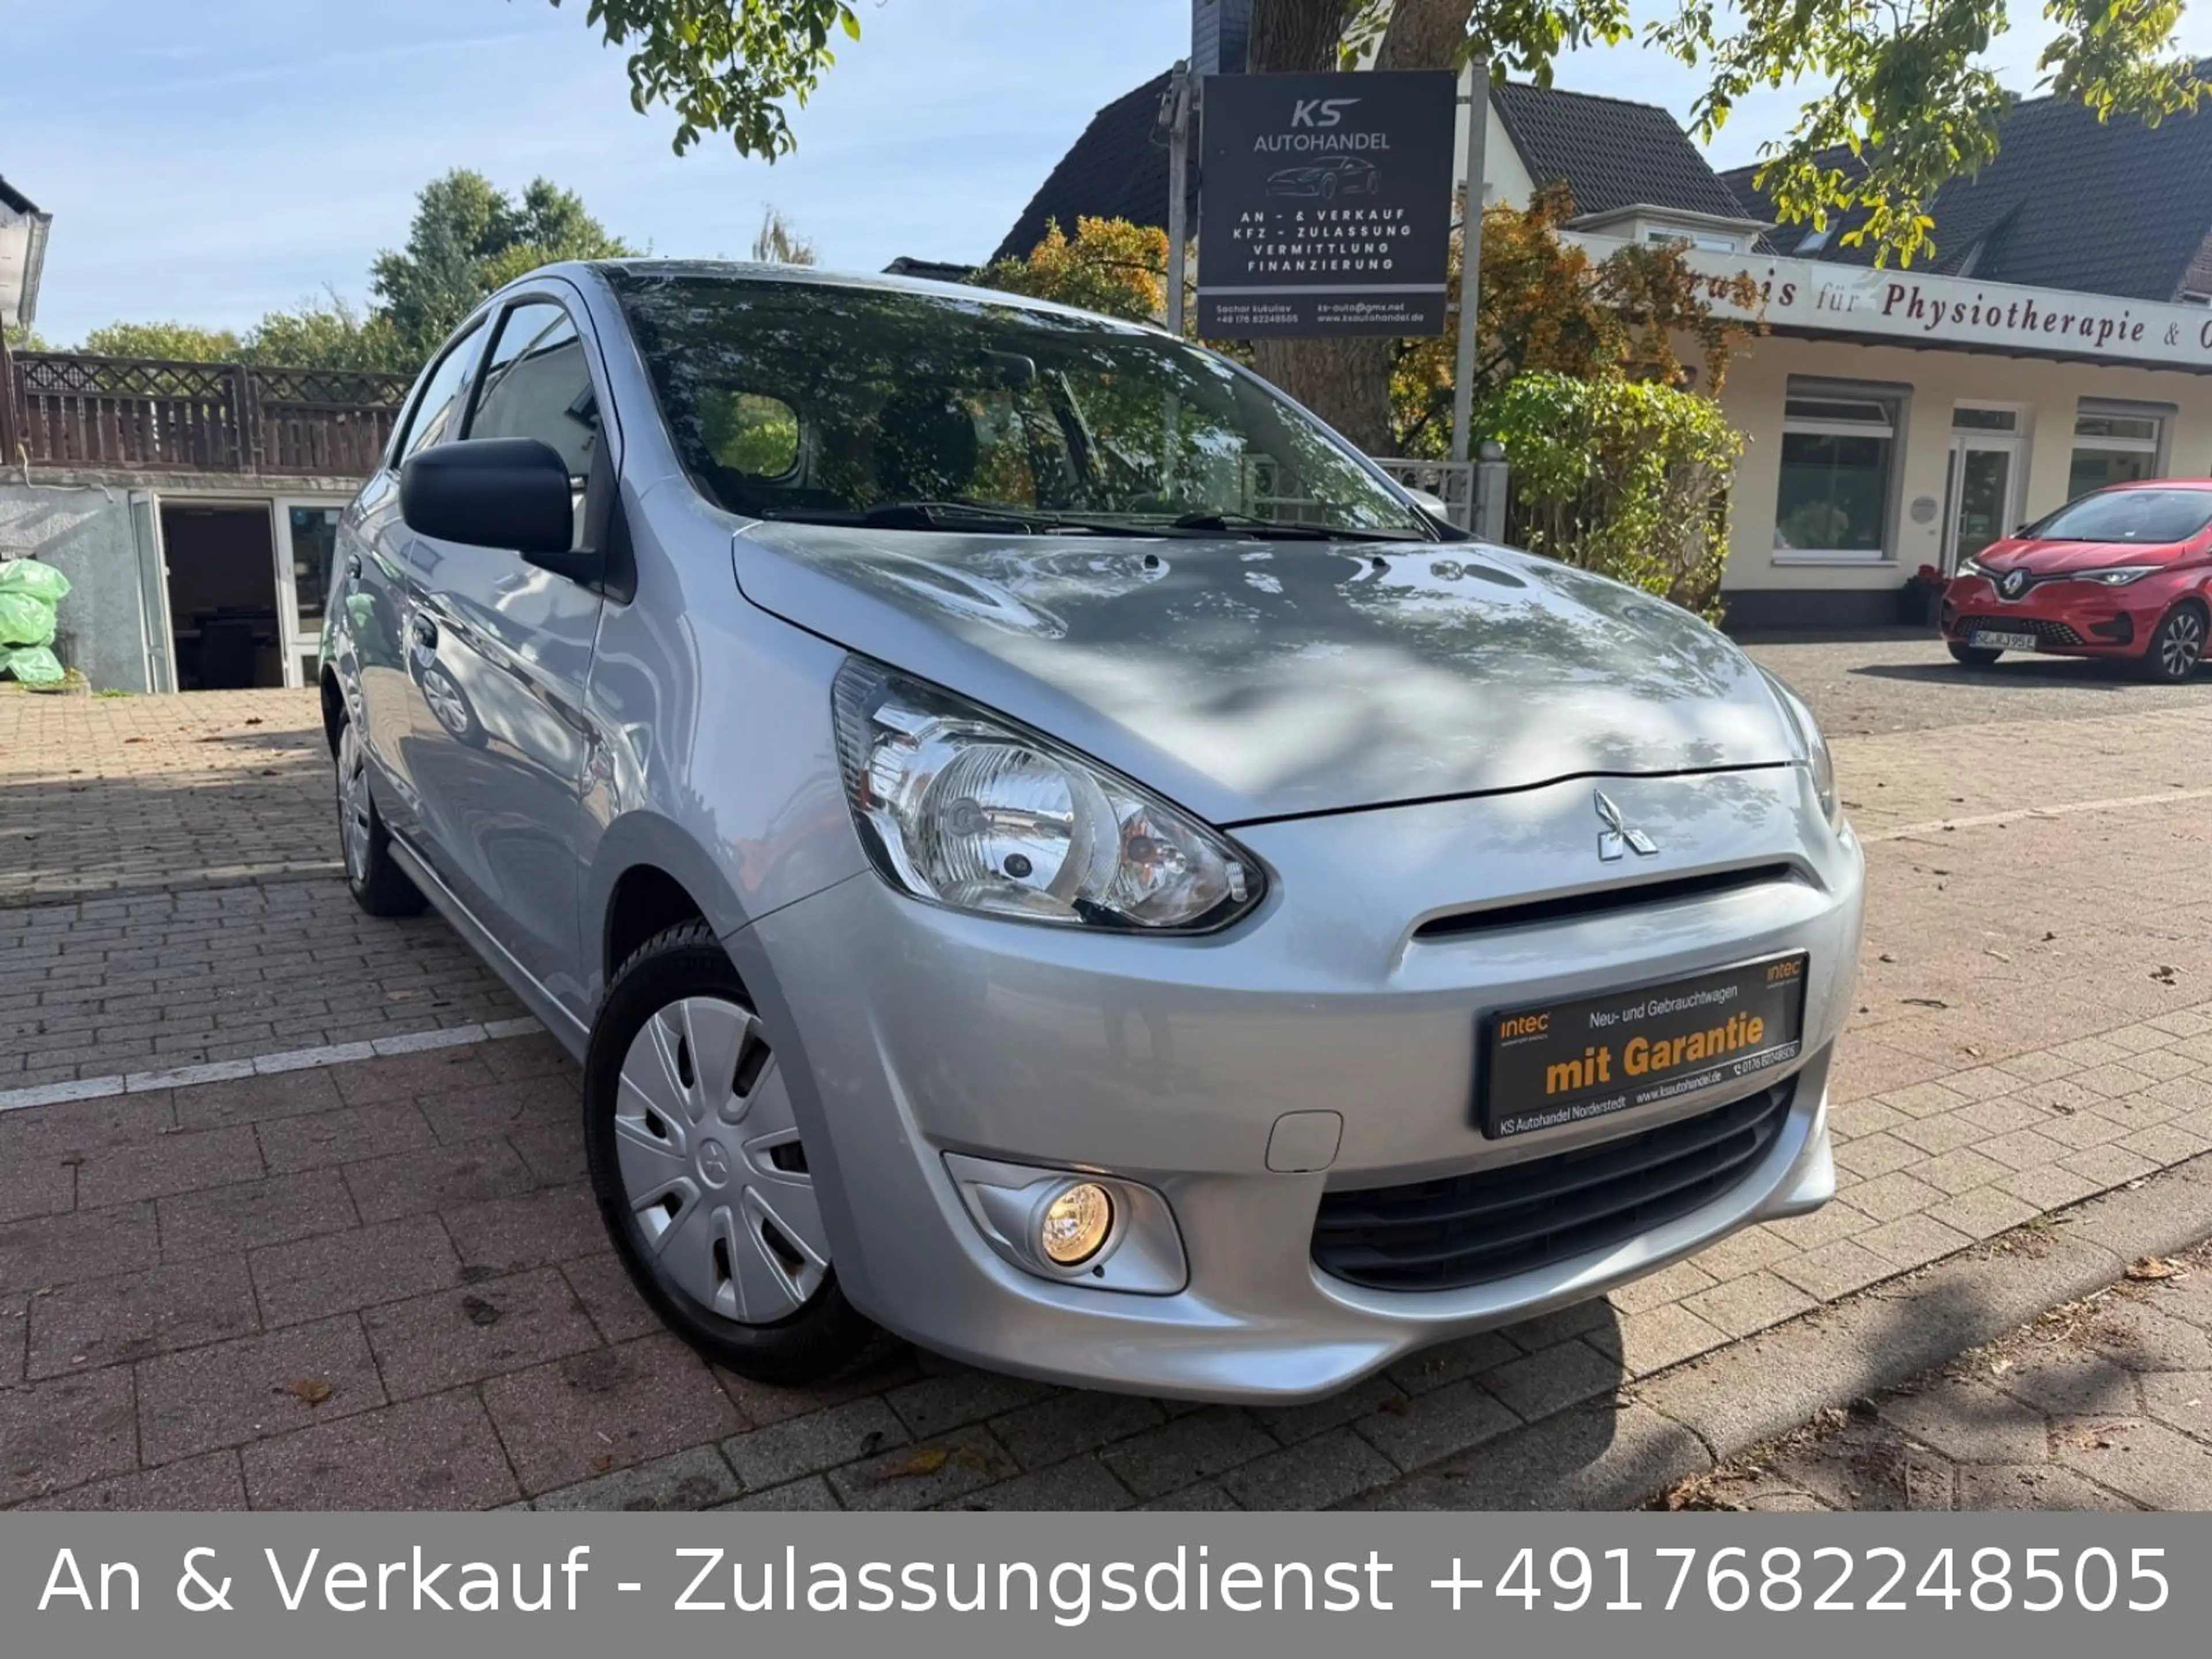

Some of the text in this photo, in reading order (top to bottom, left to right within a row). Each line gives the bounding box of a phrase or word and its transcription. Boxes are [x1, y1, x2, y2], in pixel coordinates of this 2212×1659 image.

[1291, 98, 1362, 127] KS
[1253, 132, 1391, 152] AUTOHANDEL
[1240, 211, 1264, 222] AN
[1296, 211, 1304, 221] &
[1317, 209, 1404, 221] VERKAUF
[1233, 228, 1266, 239] KFZ
[1297, 225, 1411, 238] ZULASSUNG
[1253, 243, 1388, 256] VERMITTLUNG
[1248, 259, 1393, 272] FINANZIERUNG
[1816, 282, 1861, 312] für
[1881, 283, 2145, 347] Physiotherapie
[2164, 321, 2179, 346] &
[1766, 961, 1800, 982] intec
[1589, 985, 1738, 1029] Neu- und Gebrauchtwagen
[1500, 1013, 1549, 1039] intec
[1546, 1012, 1764, 1094] mit Garantie
[1500, 1119, 1514, 1135] KS
[1516, 1108, 1570, 1132] Autohandel
[1573, 1096, 1627, 1119] Norderstedt
[1636, 1070, 1722, 1103] www.ksautohandel.de
